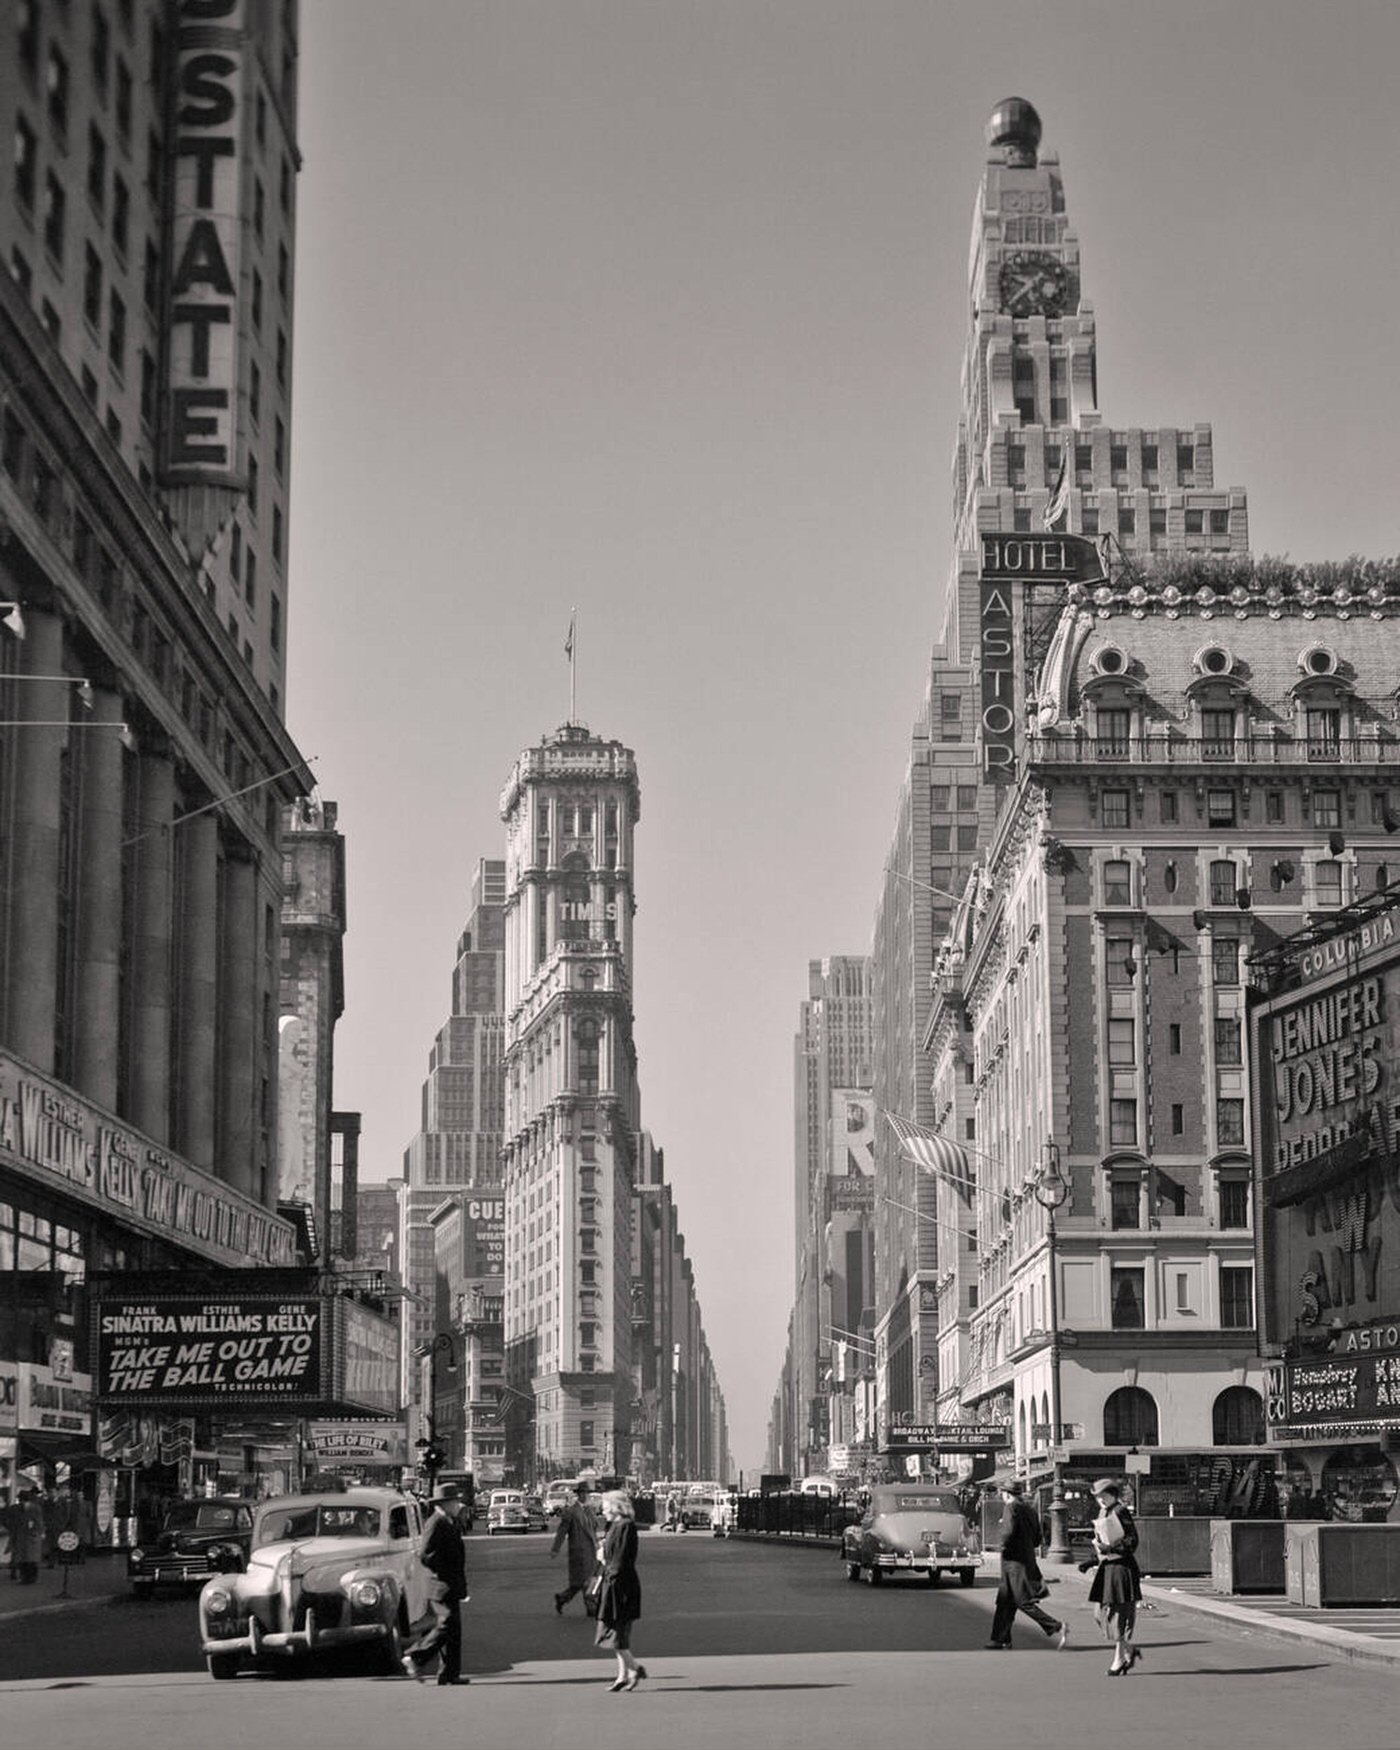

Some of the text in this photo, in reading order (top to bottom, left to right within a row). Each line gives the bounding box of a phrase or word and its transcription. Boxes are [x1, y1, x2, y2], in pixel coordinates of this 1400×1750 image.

[170, 54, 237, 465] STATE
[981, 541, 1076, 571] HOTEL
[982, 589, 1014, 774] ASTOR
[1302, 917, 1394, 976] COLUMBIA
[1274, 977, 1382, 1063] JENNIFER
[1277, 1035, 1379, 1123] JONES
[19, 1080, 96, 1188] WILLIAMS
[98, 1126, 139, 1211] KELLY
[469, 1201, 503, 1220] CUE
[101, 1313, 318, 1334] SINATRA WILLIAMS KELLY
[122, 1304, 306, 1316] FRANK ESTHER GENE
[109, 1333, 313, 1371] TAKE ME OUT TO
[107, 1368, 158, 1393] THE
[161, 1362, 227, 1388] BALL
[234, 1354, 310, 1381] GAME
[1291, 1385, 1358, 1413] BOGART
[326, 1435, 345, 1447] LIFE
[346, 1435, 359, 1446] OF
[893, 1426, 934, 1435] BROADWAY
[975, 1426, 1005, 1435] LOUNGE
